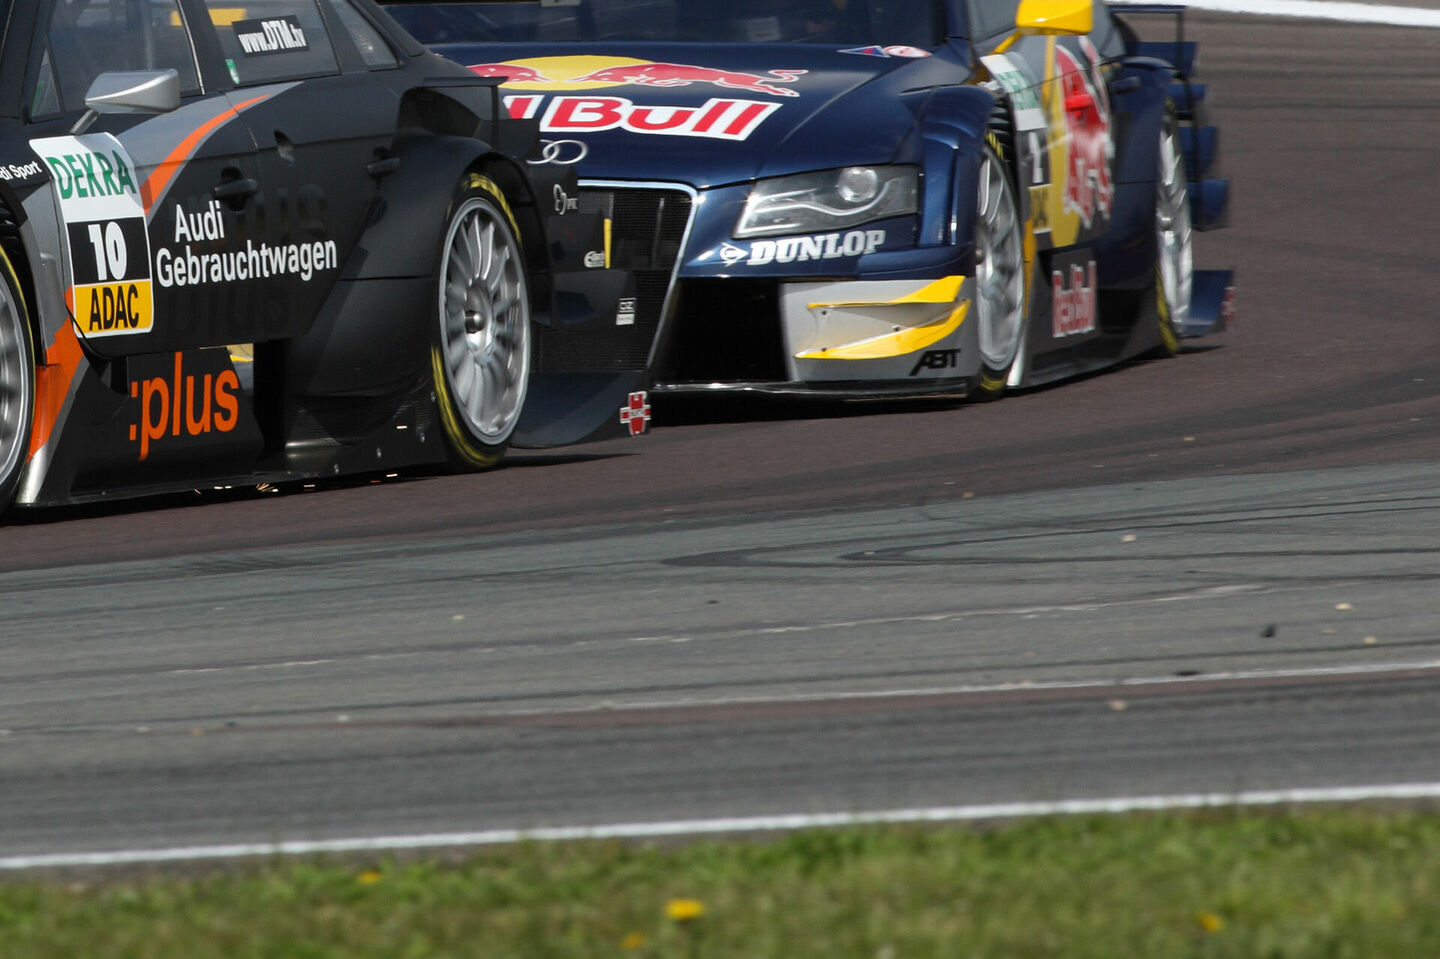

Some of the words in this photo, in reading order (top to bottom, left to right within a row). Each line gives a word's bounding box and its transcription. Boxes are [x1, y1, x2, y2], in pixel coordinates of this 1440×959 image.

[237, 19, 308, 55] www.DTM.tv
[544, 96, 782, 140] Bull
[10, 160, 44, 180] Sport
[45, 149, 138, 200] DEKRA
[175, 199, 225, 243] Audi
[87, 221, 128, 281] 10
[156, 239, 339, 288] Gebrauchtwagen
[746, 229, 887, 266] DUNLOP
[88, 283, 140, 332] ADAC
[908, 348, 961, 377] ABT
